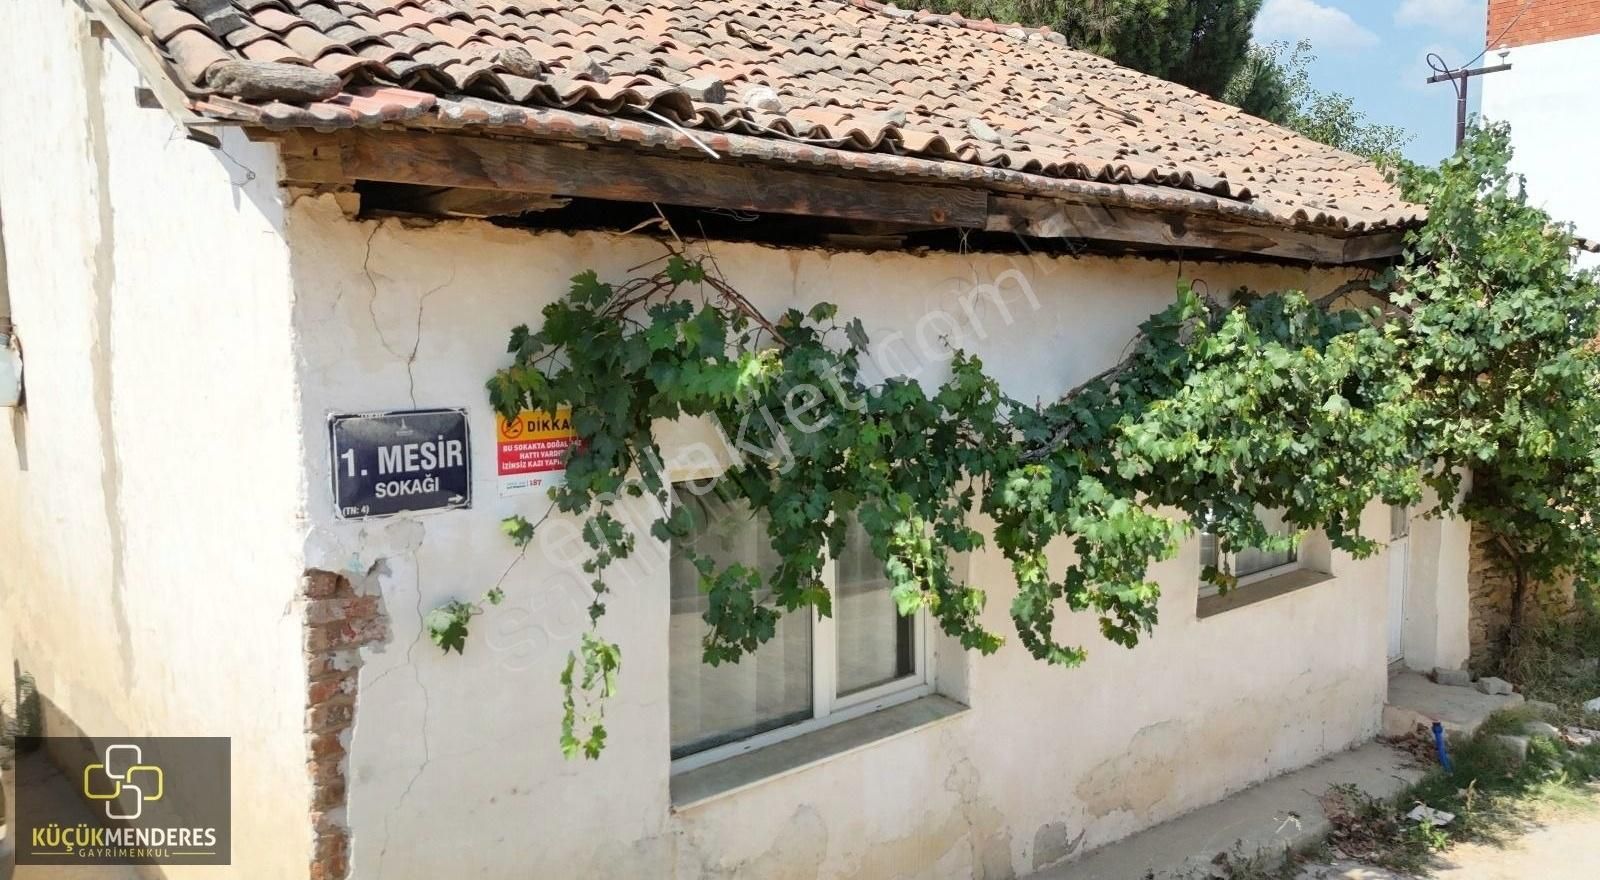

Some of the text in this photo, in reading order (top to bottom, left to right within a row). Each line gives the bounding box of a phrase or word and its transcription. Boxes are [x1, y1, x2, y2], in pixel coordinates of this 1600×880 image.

[527, 417, 574, 432] DİKKA
[502, 444, 513, 452] BU
[513, 442, 545, 451] SOKAKTA
[546, 440, 568, 449] DOĞAL
[341, 434, 463, 477] 1. MESİR
[519, 451, 540, 460] HATTI
[502, 460, 527, 470] İZİNSİZ
[527, 459, 544, 468] KAZI
[375, 474, 439, 498] SOKAĞI
